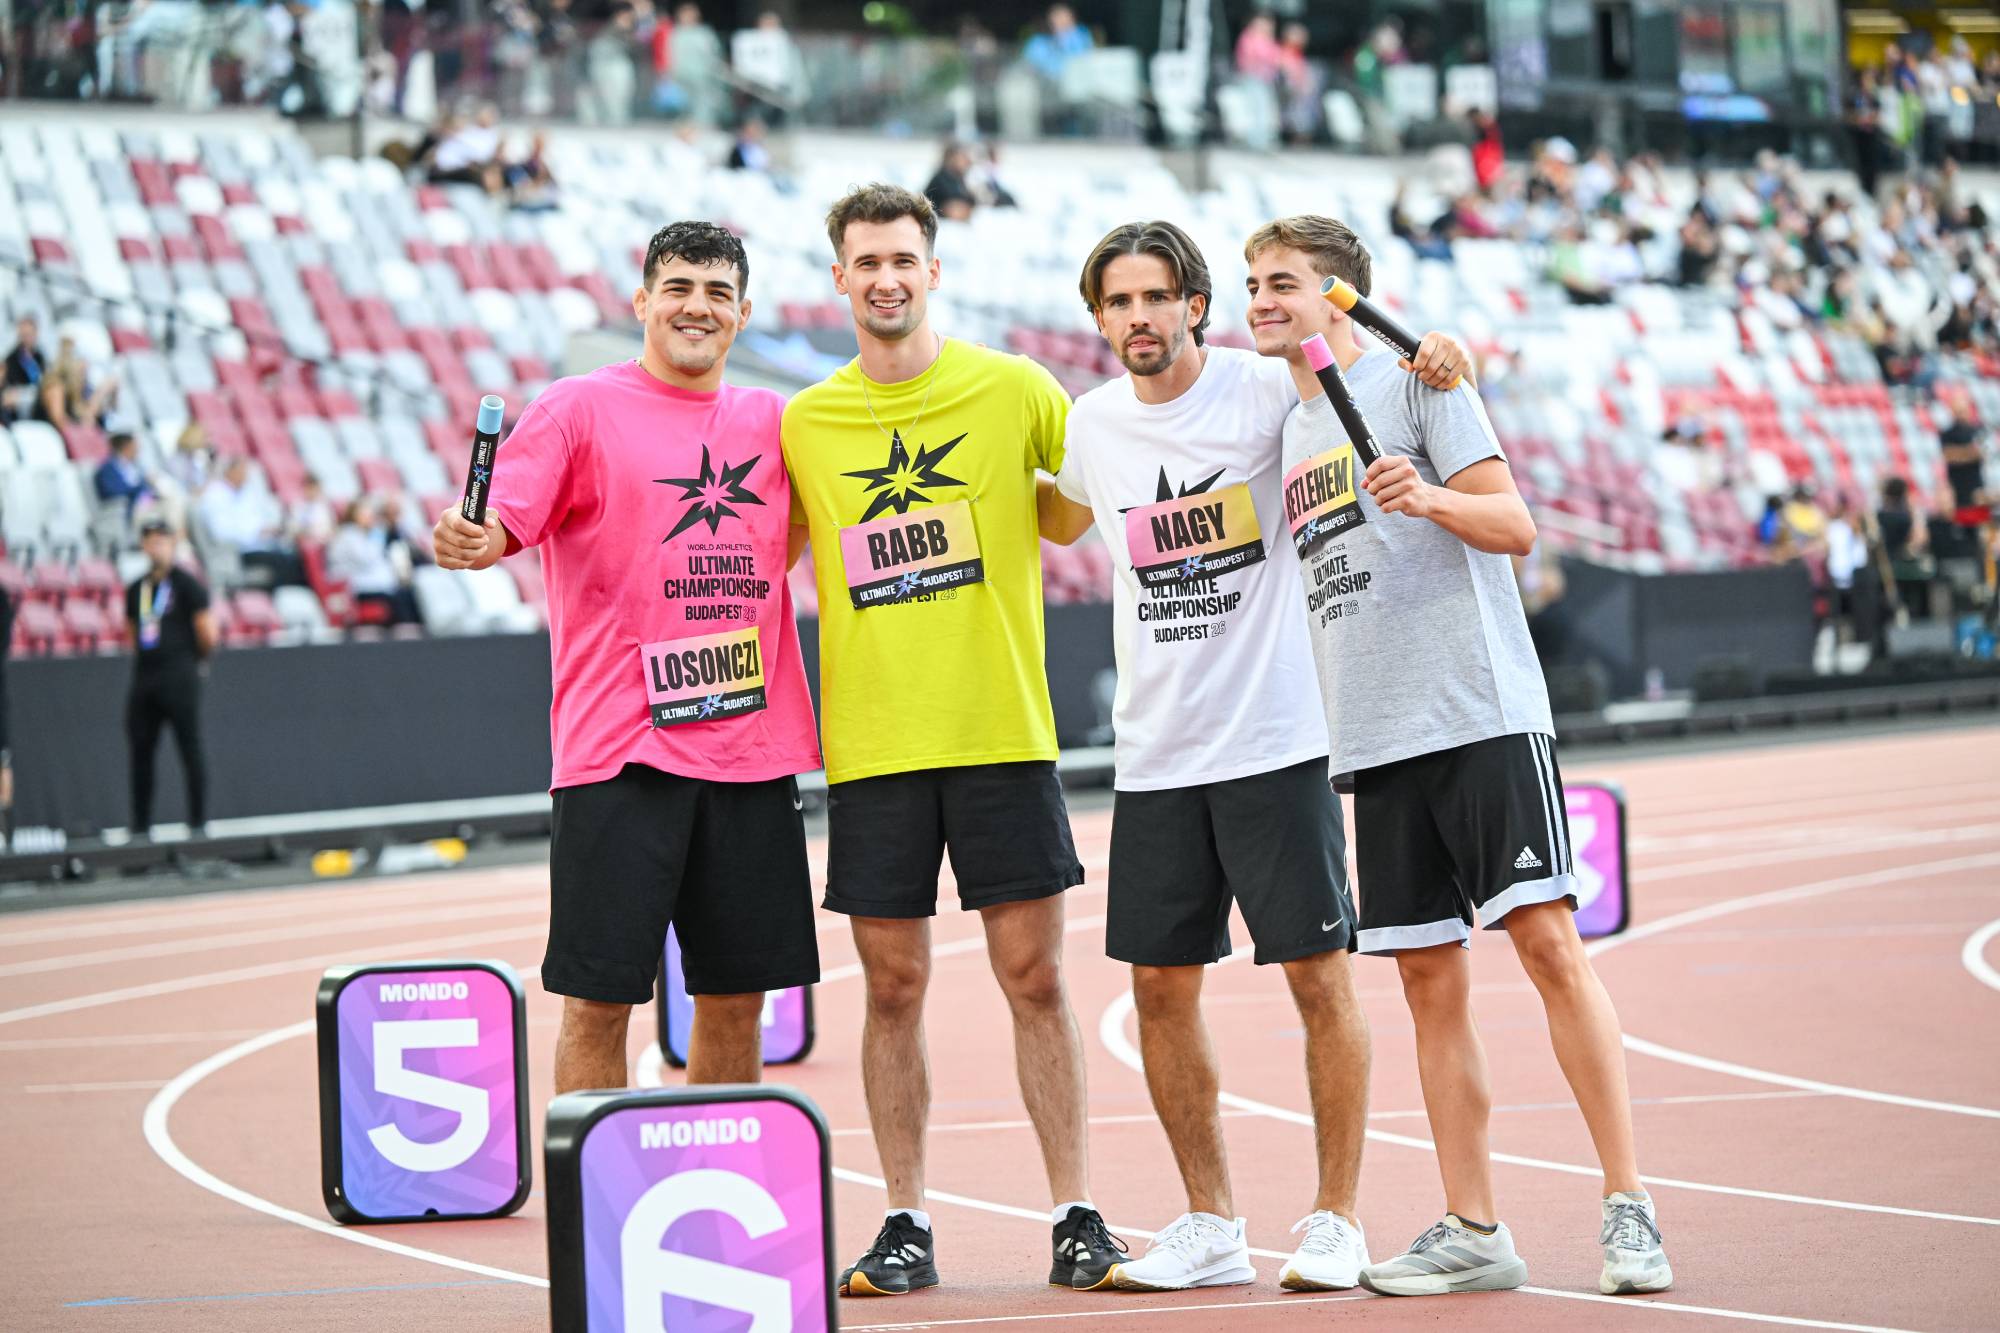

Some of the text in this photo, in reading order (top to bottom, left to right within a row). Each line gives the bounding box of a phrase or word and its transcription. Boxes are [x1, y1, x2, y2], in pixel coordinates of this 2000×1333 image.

[1374, 328, 1411, 359] MONDO
[1285, 456, 1349, 525] BETLEHEM
[1150, 502, 1227, 553] NAGY
[1318, 513, 1348, 534] BUDAPEST
[687, 543, 753, 552] WORLD ATHLETICS
[867, 519, 949, 571] RABB
[688, 555, 755, 576] ULTIMATE
[1146, 568, 1180, 582] ULTIMATE
[1204, 551, 1245, 571] BUDAPEST
[664, 577, 770, 600] CHAMPIONSHIP
[860, 585, 897, 602] ULTIMATE
[922, 569, 964, 588] BUDAPEST
[1151, 577, 1219, 599] ULTIMATE
[1308, 571, 1372, 613] CHAIONSHIP
[685, 604, 757, 622] BUDAPEST 26
[1138, 591, 1242, 622] CHAMPIONSHIP
[1344, 599, 1360, 617] 26
[1154, 620, 1227, 643] BUDAPEST 26
[650, 639, 760, 693] LOSONCZI
[661, 705, 699, 720] ULTIMATE
[723, 695, 754, 710] BUDAPEST
[1514, 858, 1543, 869] adidas
[379, 982, 469, 1003] MONDO
[367, 1018, 490, 1172] 5
[639, 1116, 761, 1150] MONDO
[620, 1168, 793, 1333] 6
